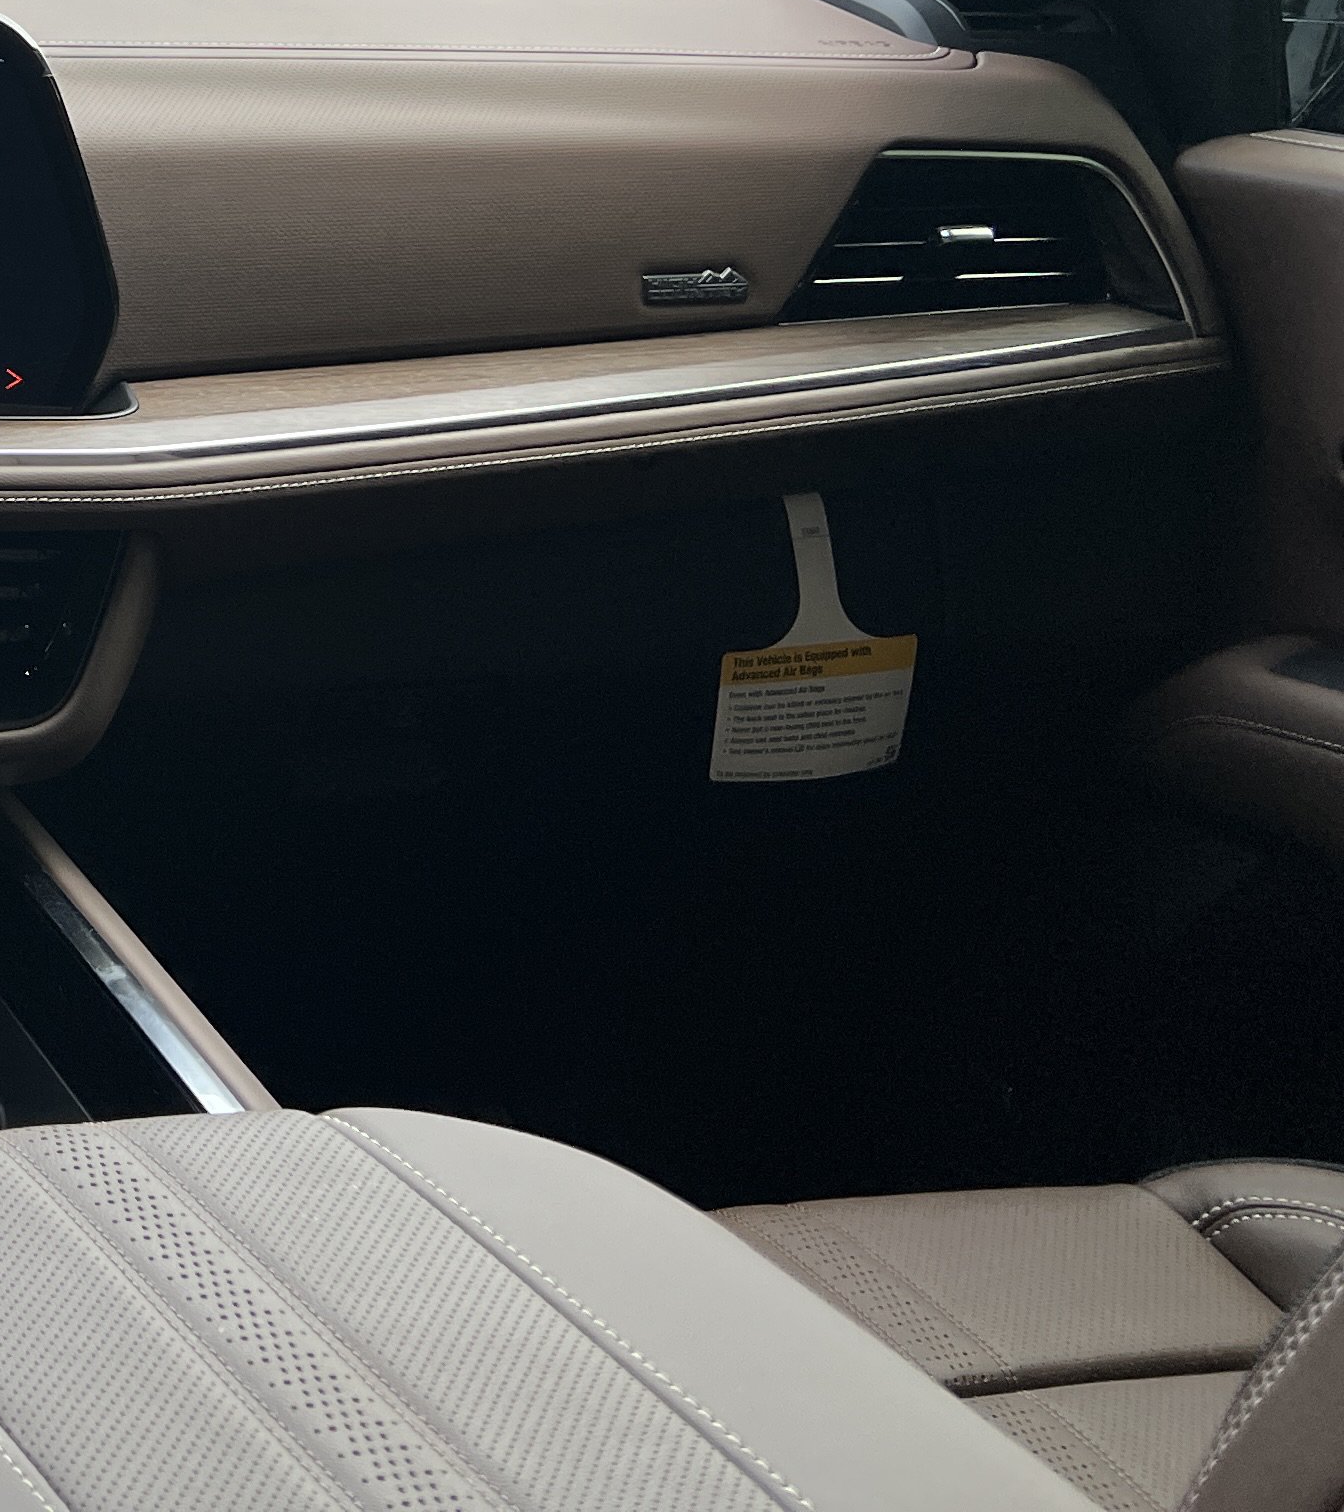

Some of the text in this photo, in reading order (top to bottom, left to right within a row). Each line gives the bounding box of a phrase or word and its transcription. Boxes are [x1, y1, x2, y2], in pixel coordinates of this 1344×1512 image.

[733, 656, 754, 668] This
[756, 654, 792, 667] Vehicle
[804, 648, 849, 663] Equipped
[850, 645, 872, 657] with
[731, 666, 781, 681] Advanced
[782, 665, 798, 677] Air
